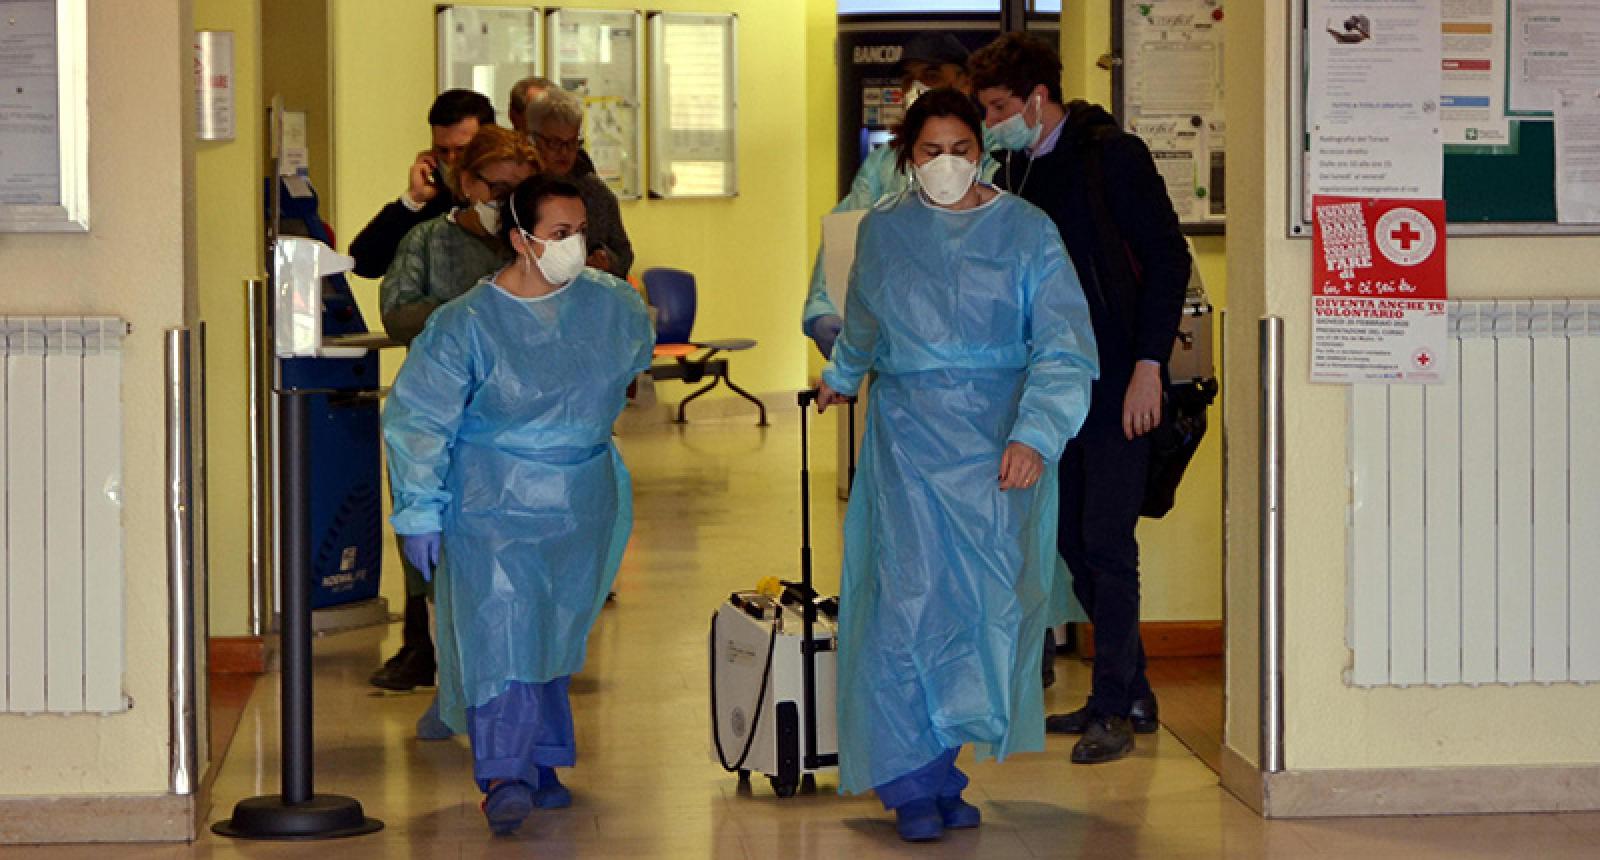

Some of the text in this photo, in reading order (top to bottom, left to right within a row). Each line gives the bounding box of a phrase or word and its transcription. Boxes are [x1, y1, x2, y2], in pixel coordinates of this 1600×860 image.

[1315, 298, 1445, 311] DIVENTA ANCHE TU
[1315, 308, 1405, 319] VOLONTARIO
